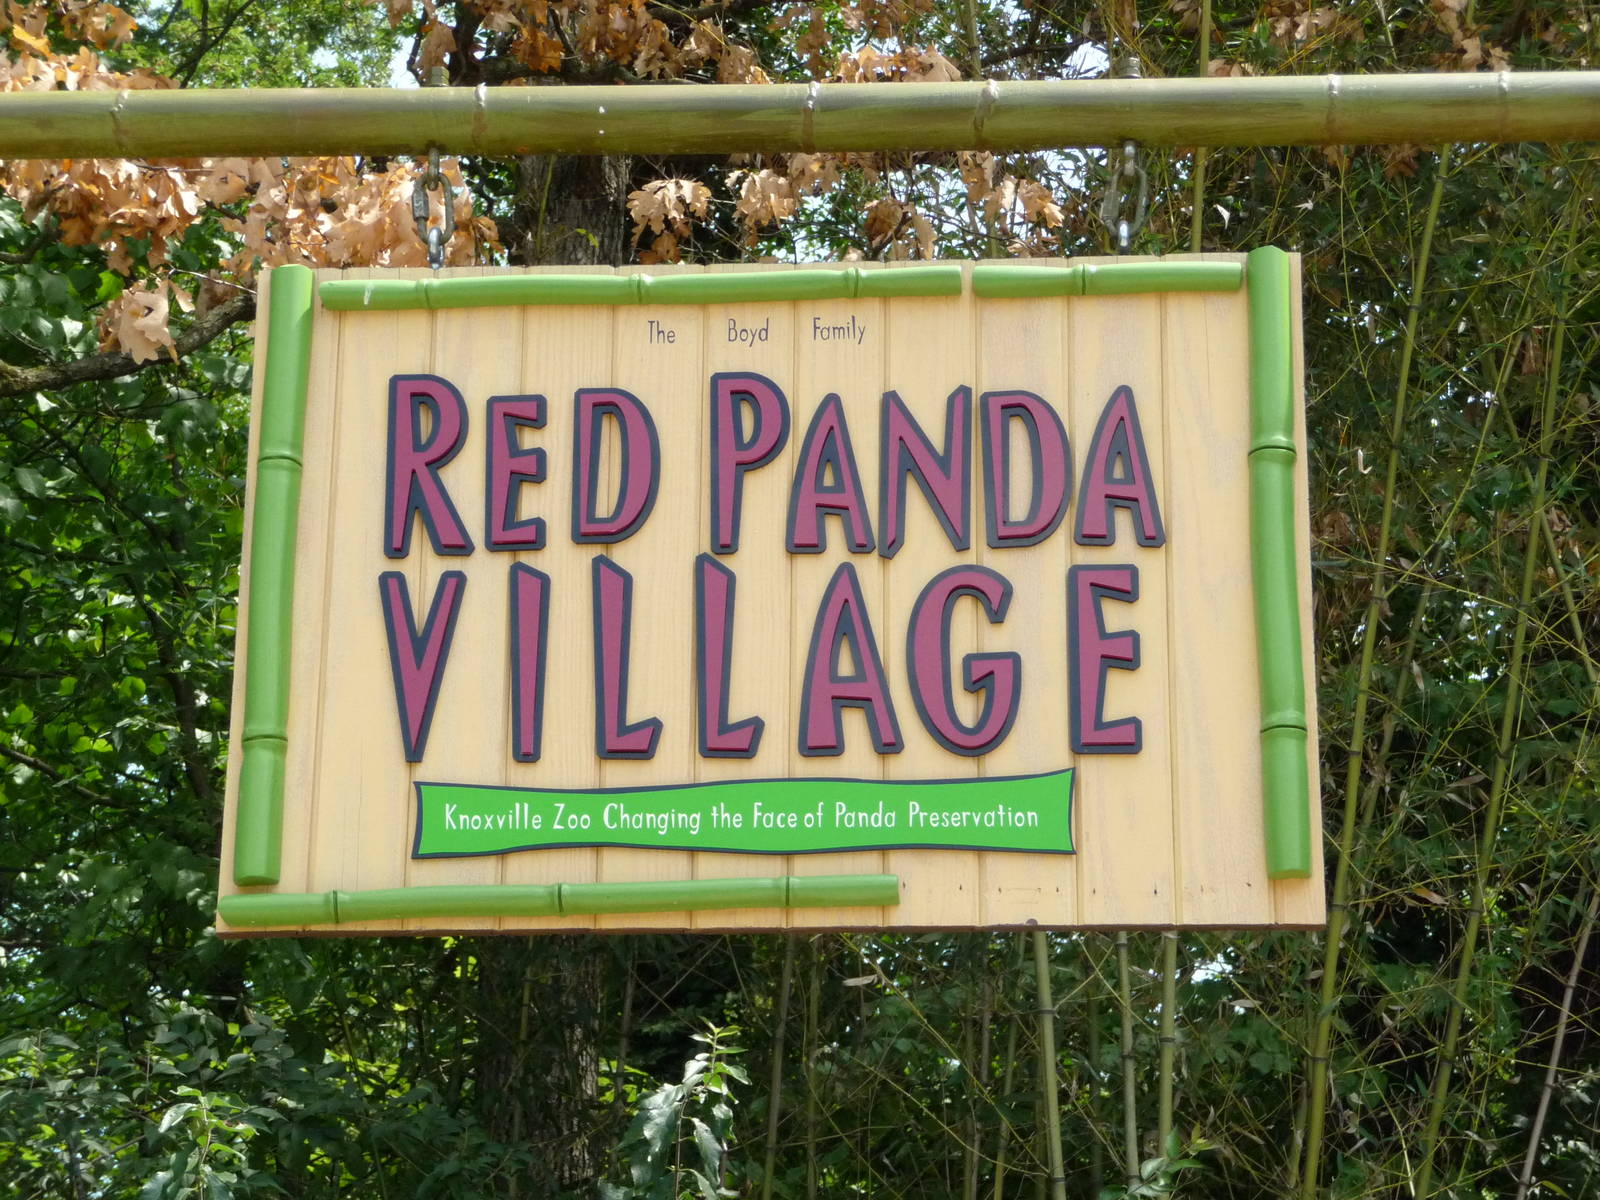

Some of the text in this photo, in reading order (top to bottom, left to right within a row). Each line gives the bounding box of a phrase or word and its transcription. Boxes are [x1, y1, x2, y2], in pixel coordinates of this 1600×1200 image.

[648, 315, 866, 348] The Boyd Family
[384, 372, 1166, 559] RED PANDA
[379, 553, 1142, 762] VILLAGE
[444, 801, 1039, 836] Knoxville Zoo Changing the Face of Panda Preservation
